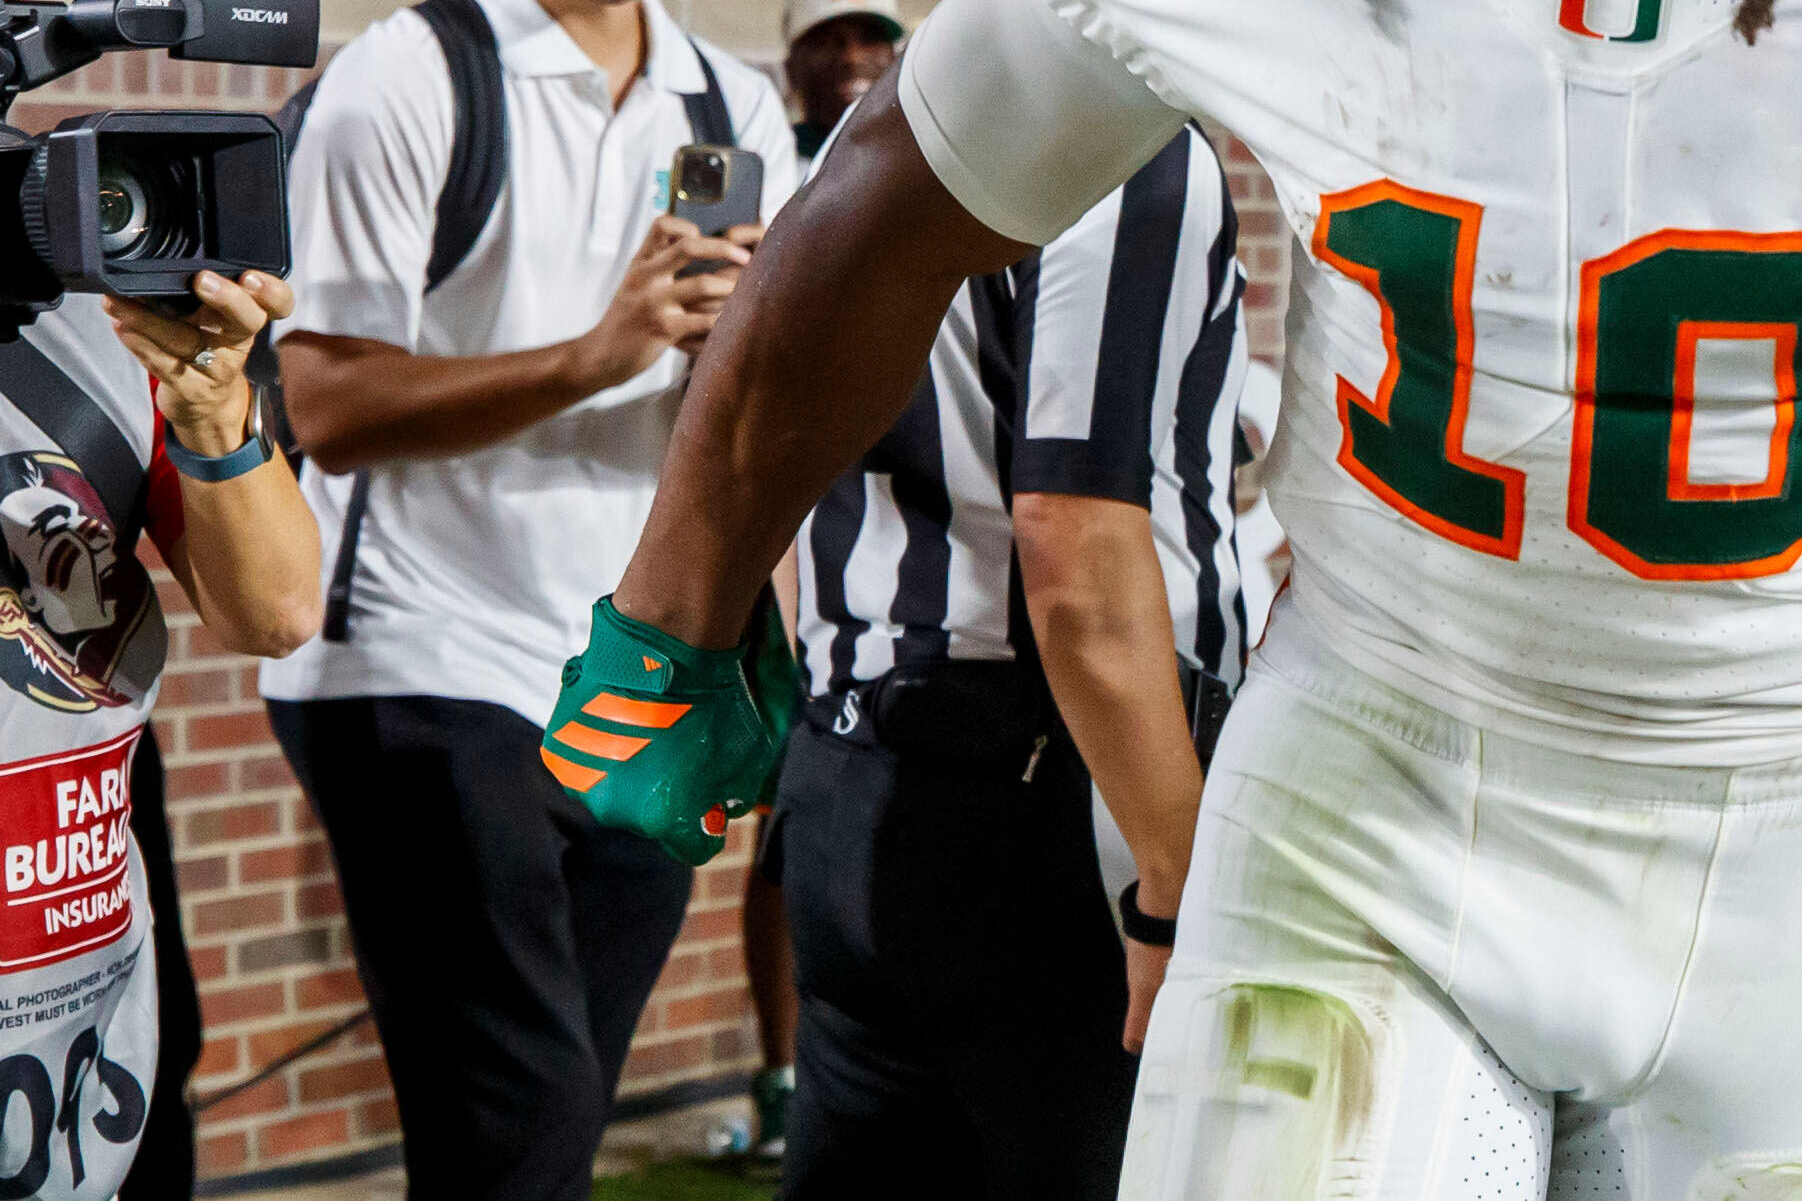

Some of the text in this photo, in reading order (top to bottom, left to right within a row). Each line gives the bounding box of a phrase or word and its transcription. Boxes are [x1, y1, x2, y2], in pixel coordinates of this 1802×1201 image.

[231, 7, 288, 25] XDCAM
[44, 869, 130, 936] INSURAN
[35, 1003, 66, 1022] MUST
[67, 998, 81, 1013] BE
